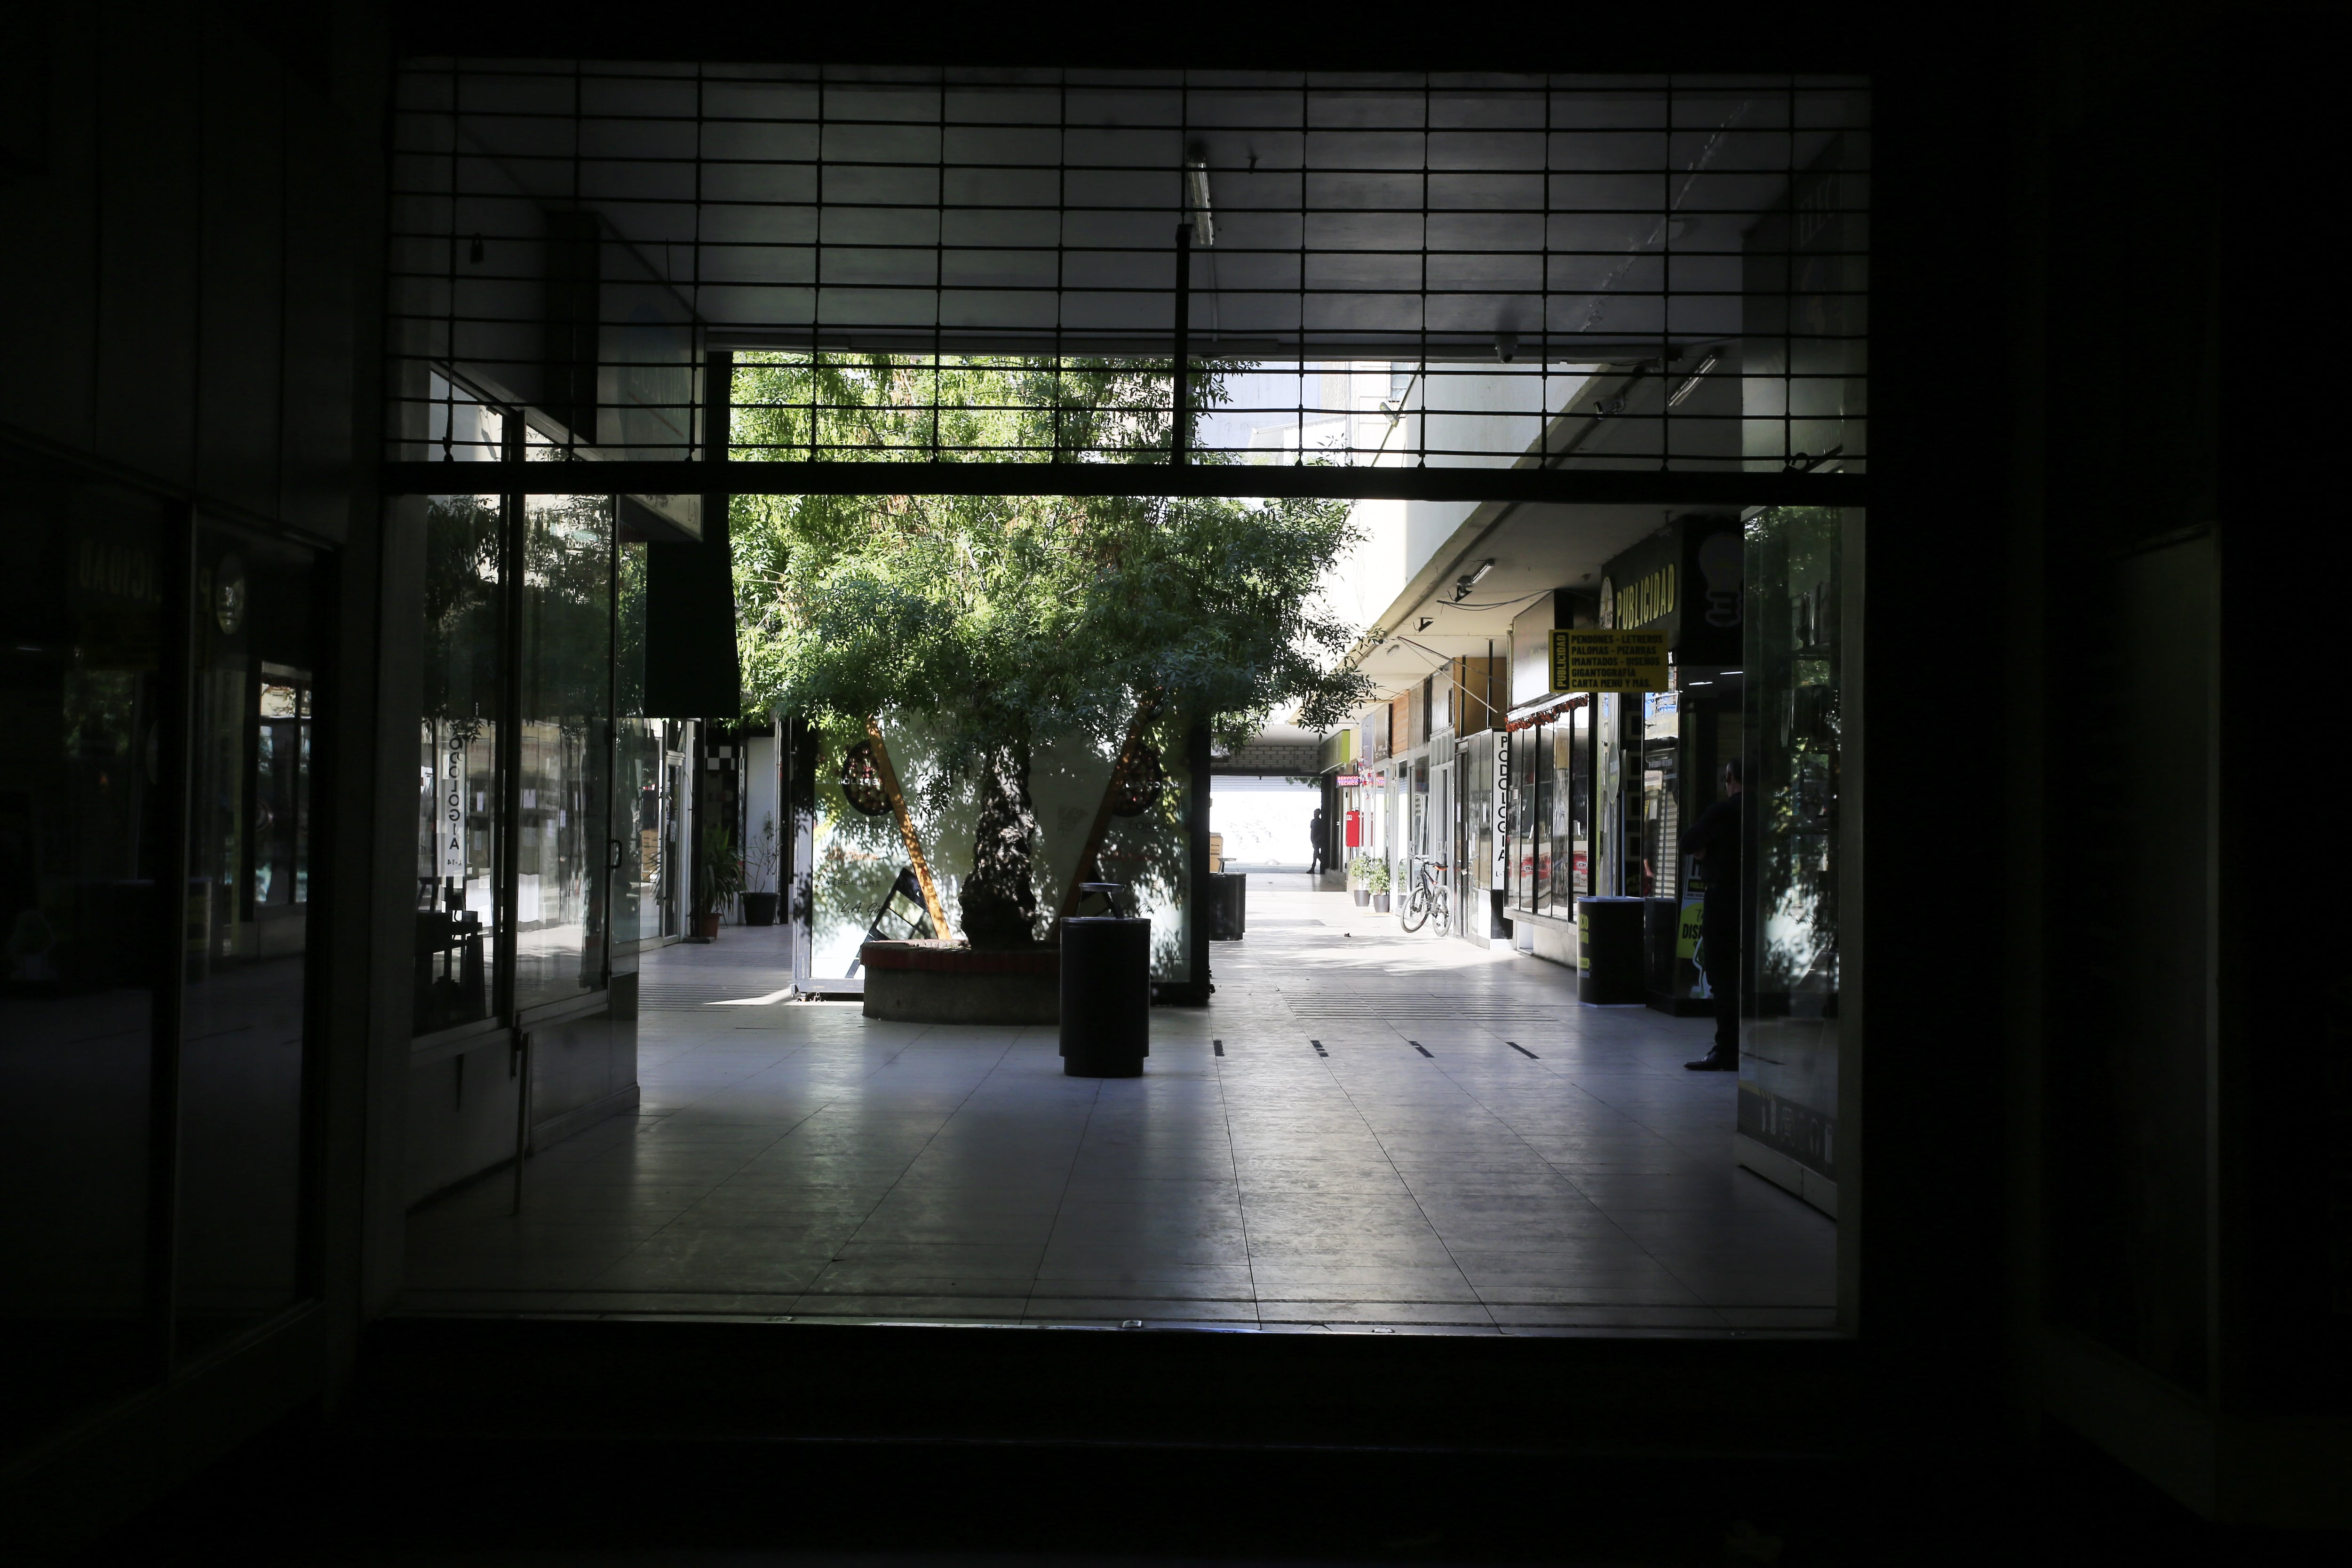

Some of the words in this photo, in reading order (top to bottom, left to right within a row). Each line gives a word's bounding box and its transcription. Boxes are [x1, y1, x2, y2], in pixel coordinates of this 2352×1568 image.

[1616, 564, 1675, 630] PUBLICIDAD
[1571, 635, 1613, 644] PENDONES
[1621, 635, 1663, 644] LETREROS
[1571, 646, 1609, 655] PALOMAS
[1617, 646, 1656, 654] PIZARRAS
[1556, 635, 1566, 687] PUBLICIDAD
[1571, 657, 1618, 666] IMANTADOS
[1572, 666, 1636, 677] GIGANTOGRAFÍA
[1572, 679, 1598, 687] CARTA
[1625, 679, 1630, 687] Y
